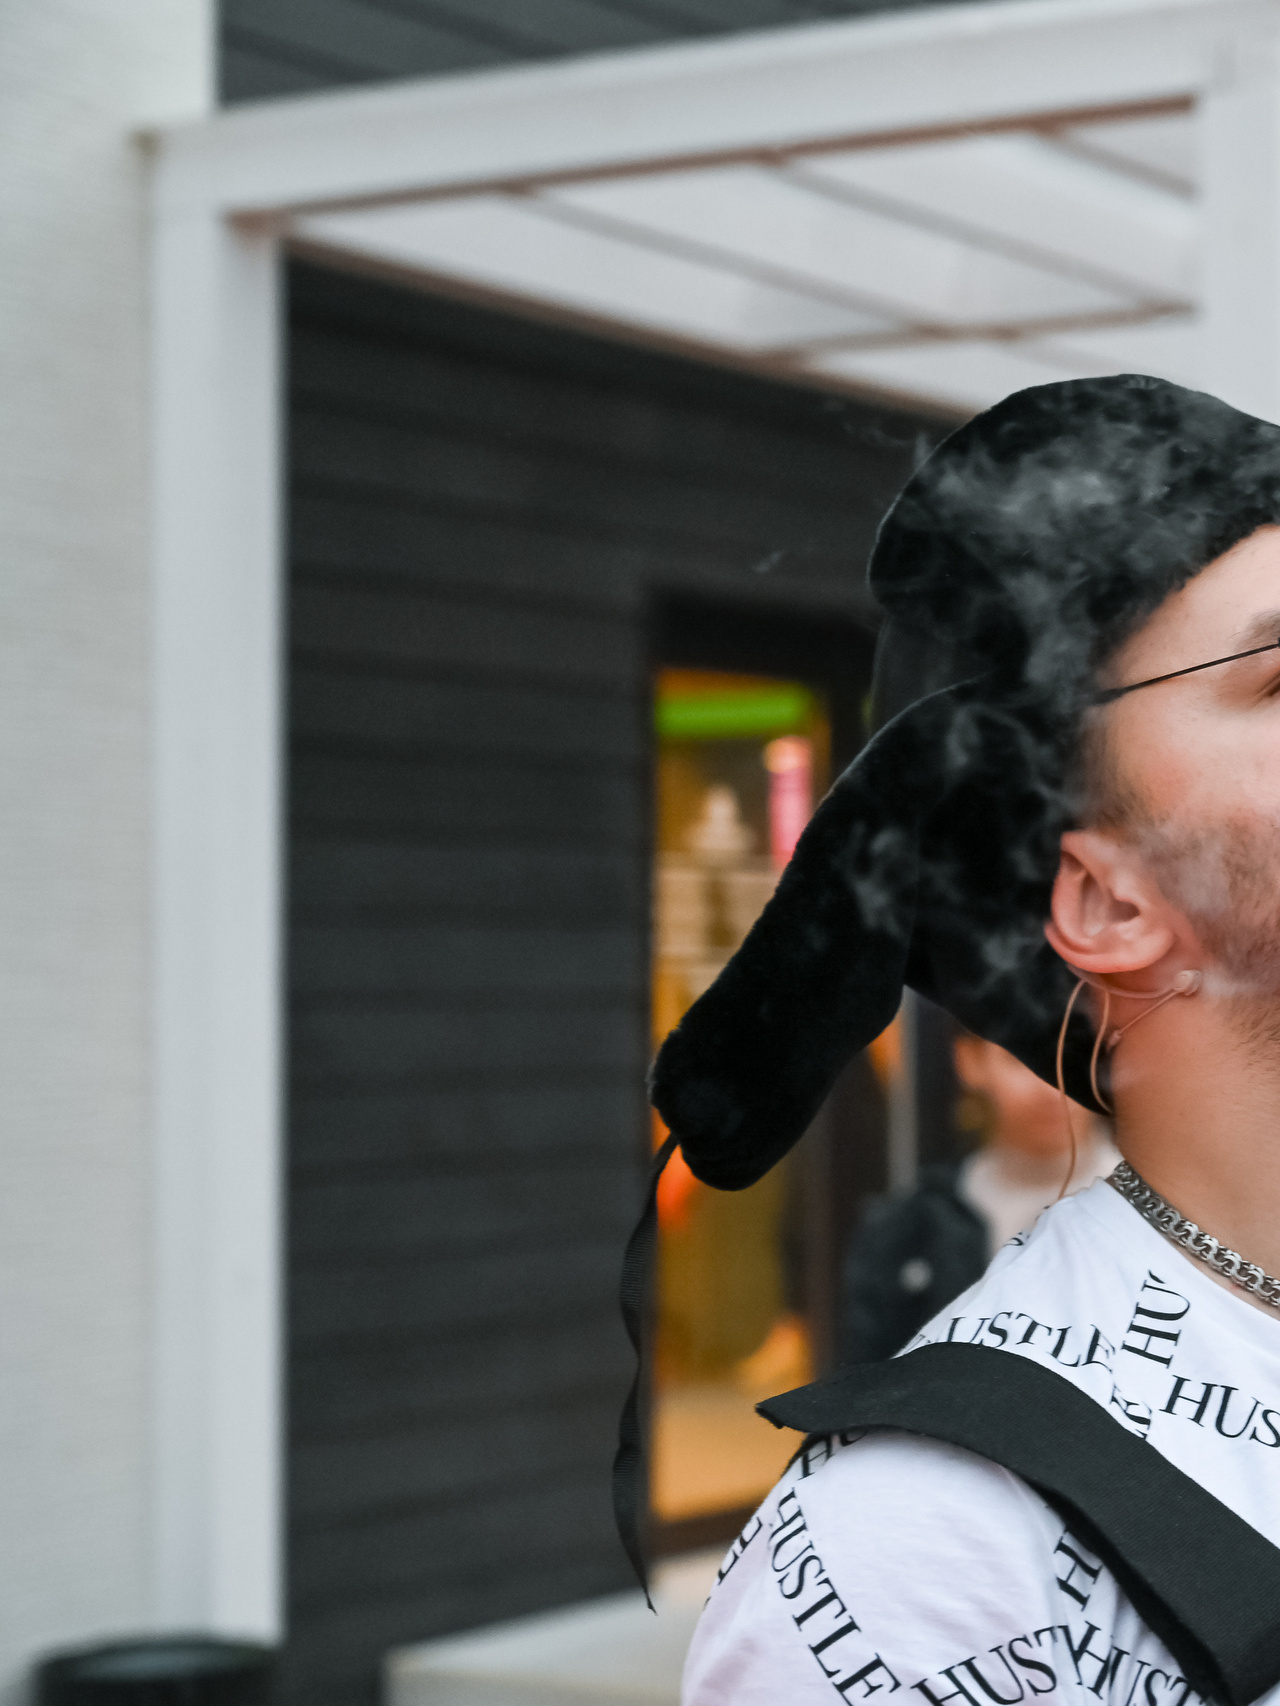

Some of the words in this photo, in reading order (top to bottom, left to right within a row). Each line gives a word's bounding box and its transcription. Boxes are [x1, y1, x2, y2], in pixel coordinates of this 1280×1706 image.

[930, 1311, 1116, 1373] USTLE
[1121, 1269, 1192, 1370] HU
[768, 1487, 902, 1706] HUSTLE
